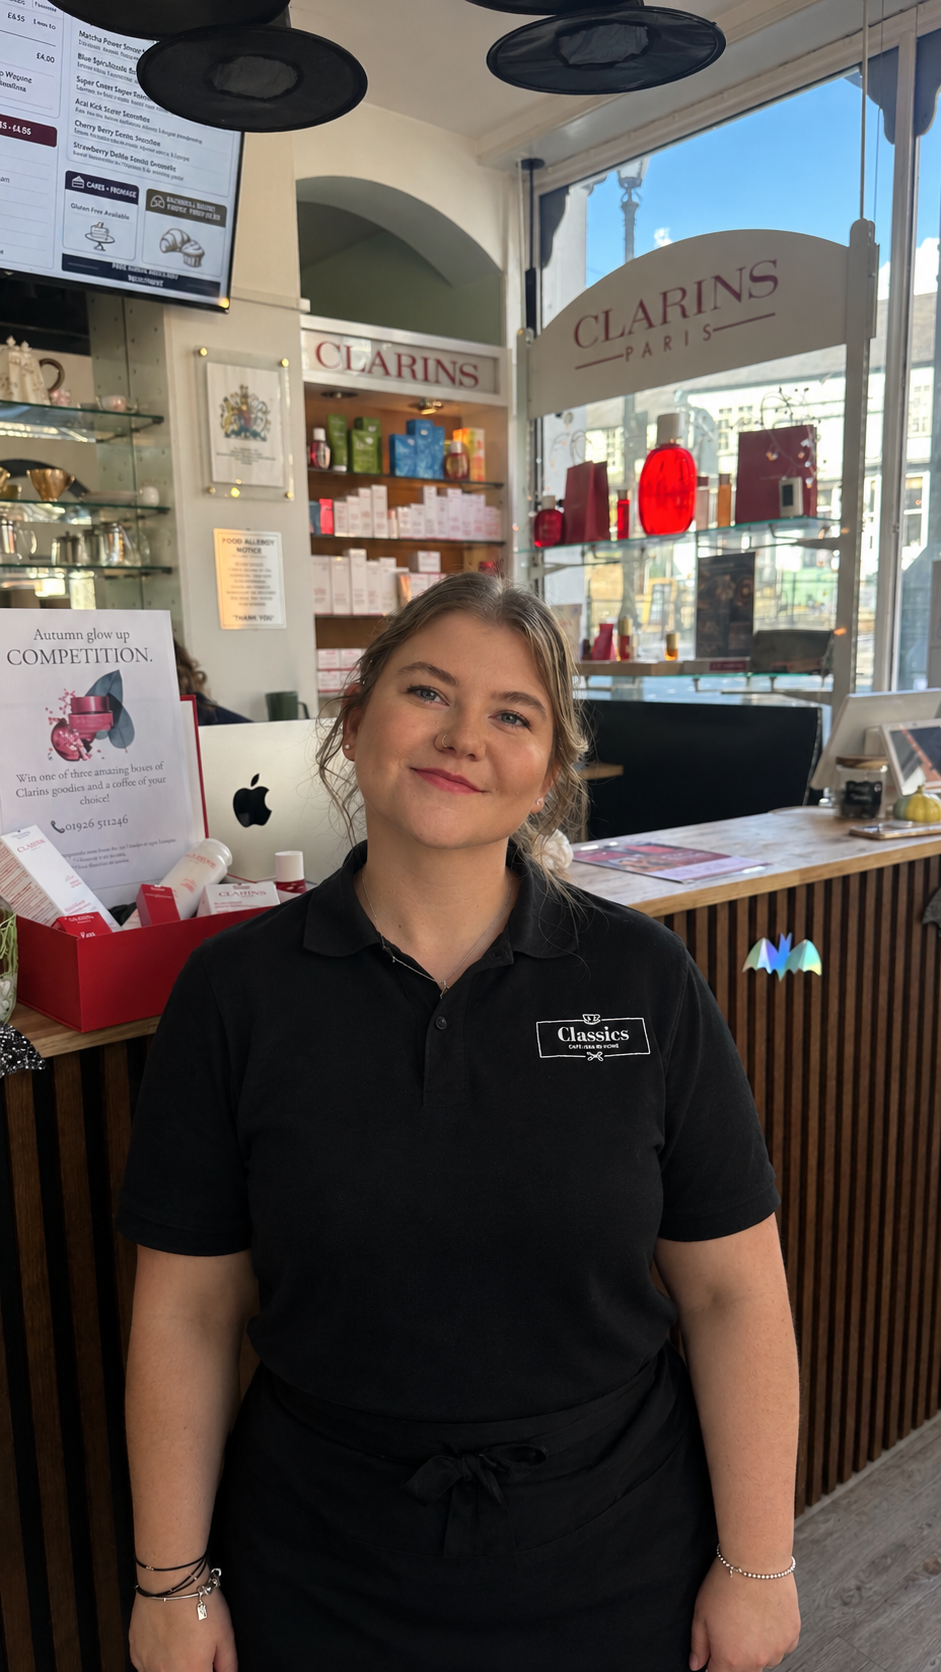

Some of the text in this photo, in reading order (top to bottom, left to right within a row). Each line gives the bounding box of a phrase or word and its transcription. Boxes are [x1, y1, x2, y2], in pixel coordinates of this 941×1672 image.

[74, 119, 96, 132] Cherry
[73, 142, 109, 157] Strawberry
[70, 203, 90, 212] Gluten
[104, 210, 130, 220] Available
[573, 259, 779, 349] CLARINS
[625, 323, 712, 362] PARIS
[315, 340, 480, 389] CLARINS
[34, 628, 130, 643] Autumn glow up
[7, 647, 153, 666] COMPETITION.
[16, 762, 164, 783] Win one of three amazing boxes of
[16, 786, 50, 798] Clarins
[51, 784, 86, 798] goodies
[87, 781, 104, 791] and
[112, 777, 136, 789] coffee
[138, 776, 148, 786] of
[147, 775, 166, 789] your
[80, 794, 110, 806] choice!
[65, 815, 129, 832] 01926 511246
[557, 1026, 630, 1042] Classics
